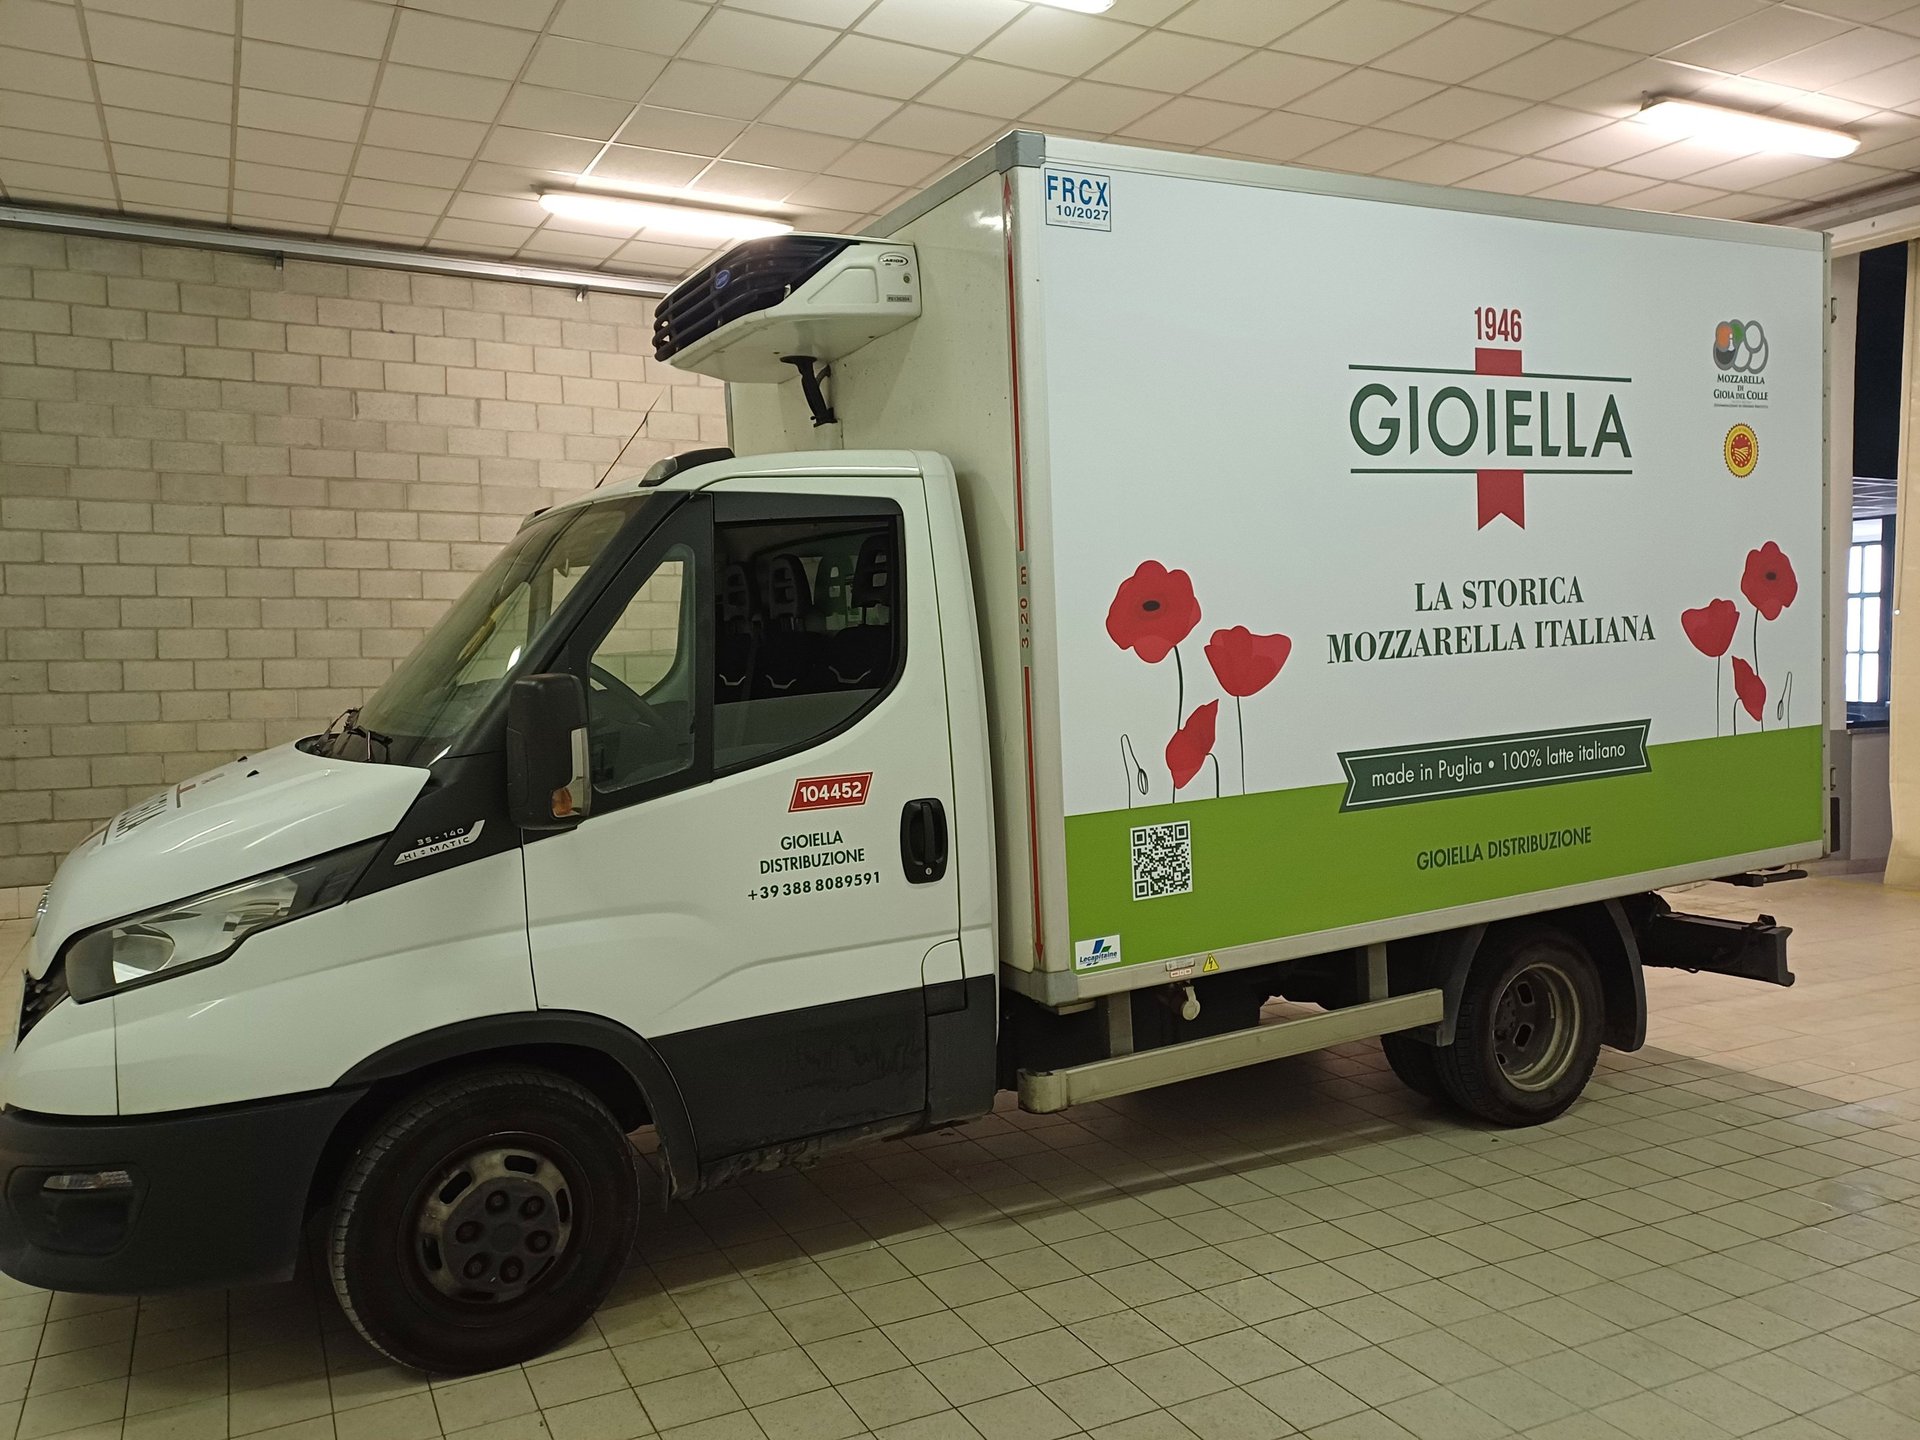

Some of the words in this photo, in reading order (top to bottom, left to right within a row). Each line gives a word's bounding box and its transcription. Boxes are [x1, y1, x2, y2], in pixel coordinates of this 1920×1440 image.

[1047, 175, 1108, 207] FRCX
[1056, 204, 1109, 221] 10/2027
[1474, 306, 1522, 342] 1946
[1717, 373, 1765, 385] MOZZARELLA
[1713, 389, 1735, 400] GIOIA
[1746, 390, 1768, 401] COLLE
[1349, 383, 1632, 458] GIOIELLA
[1020, 566, 1027, 585] m
[1414, 581, 1453, 612] LA
[1462, 575, 1584, 610] STORICA
[1326, 622, 1526, 664] MOZZARELLA
[1534, 614, 1656, 649] ITALIANA
[1372, 762, 1415, 787] made
[1420, 763, 1433, 781] in
[1438, 755, 1482, 782] Puglia
[1502, 748, 1542, 771] 100%
[1546, 745, 1574, 766] latte
[1578, 740, 1626, 762] italiano
[800, 781, 862, 802] 104452
[780, 830, 843, 850] GIOIELLA
[1416, 843, 1484, 870] GIOIELLA
[1488, 826, 1592, 860] DISTRIBUZIONE
[760, 848, 865, 874] DISTRIBUZIONE
[748, 885, 779, 901] +39
[782, 880, 811, 896] 388
[815, 871, 880, 891] 8089591
[1079, 951, 1117, 963] Lecapitaine
